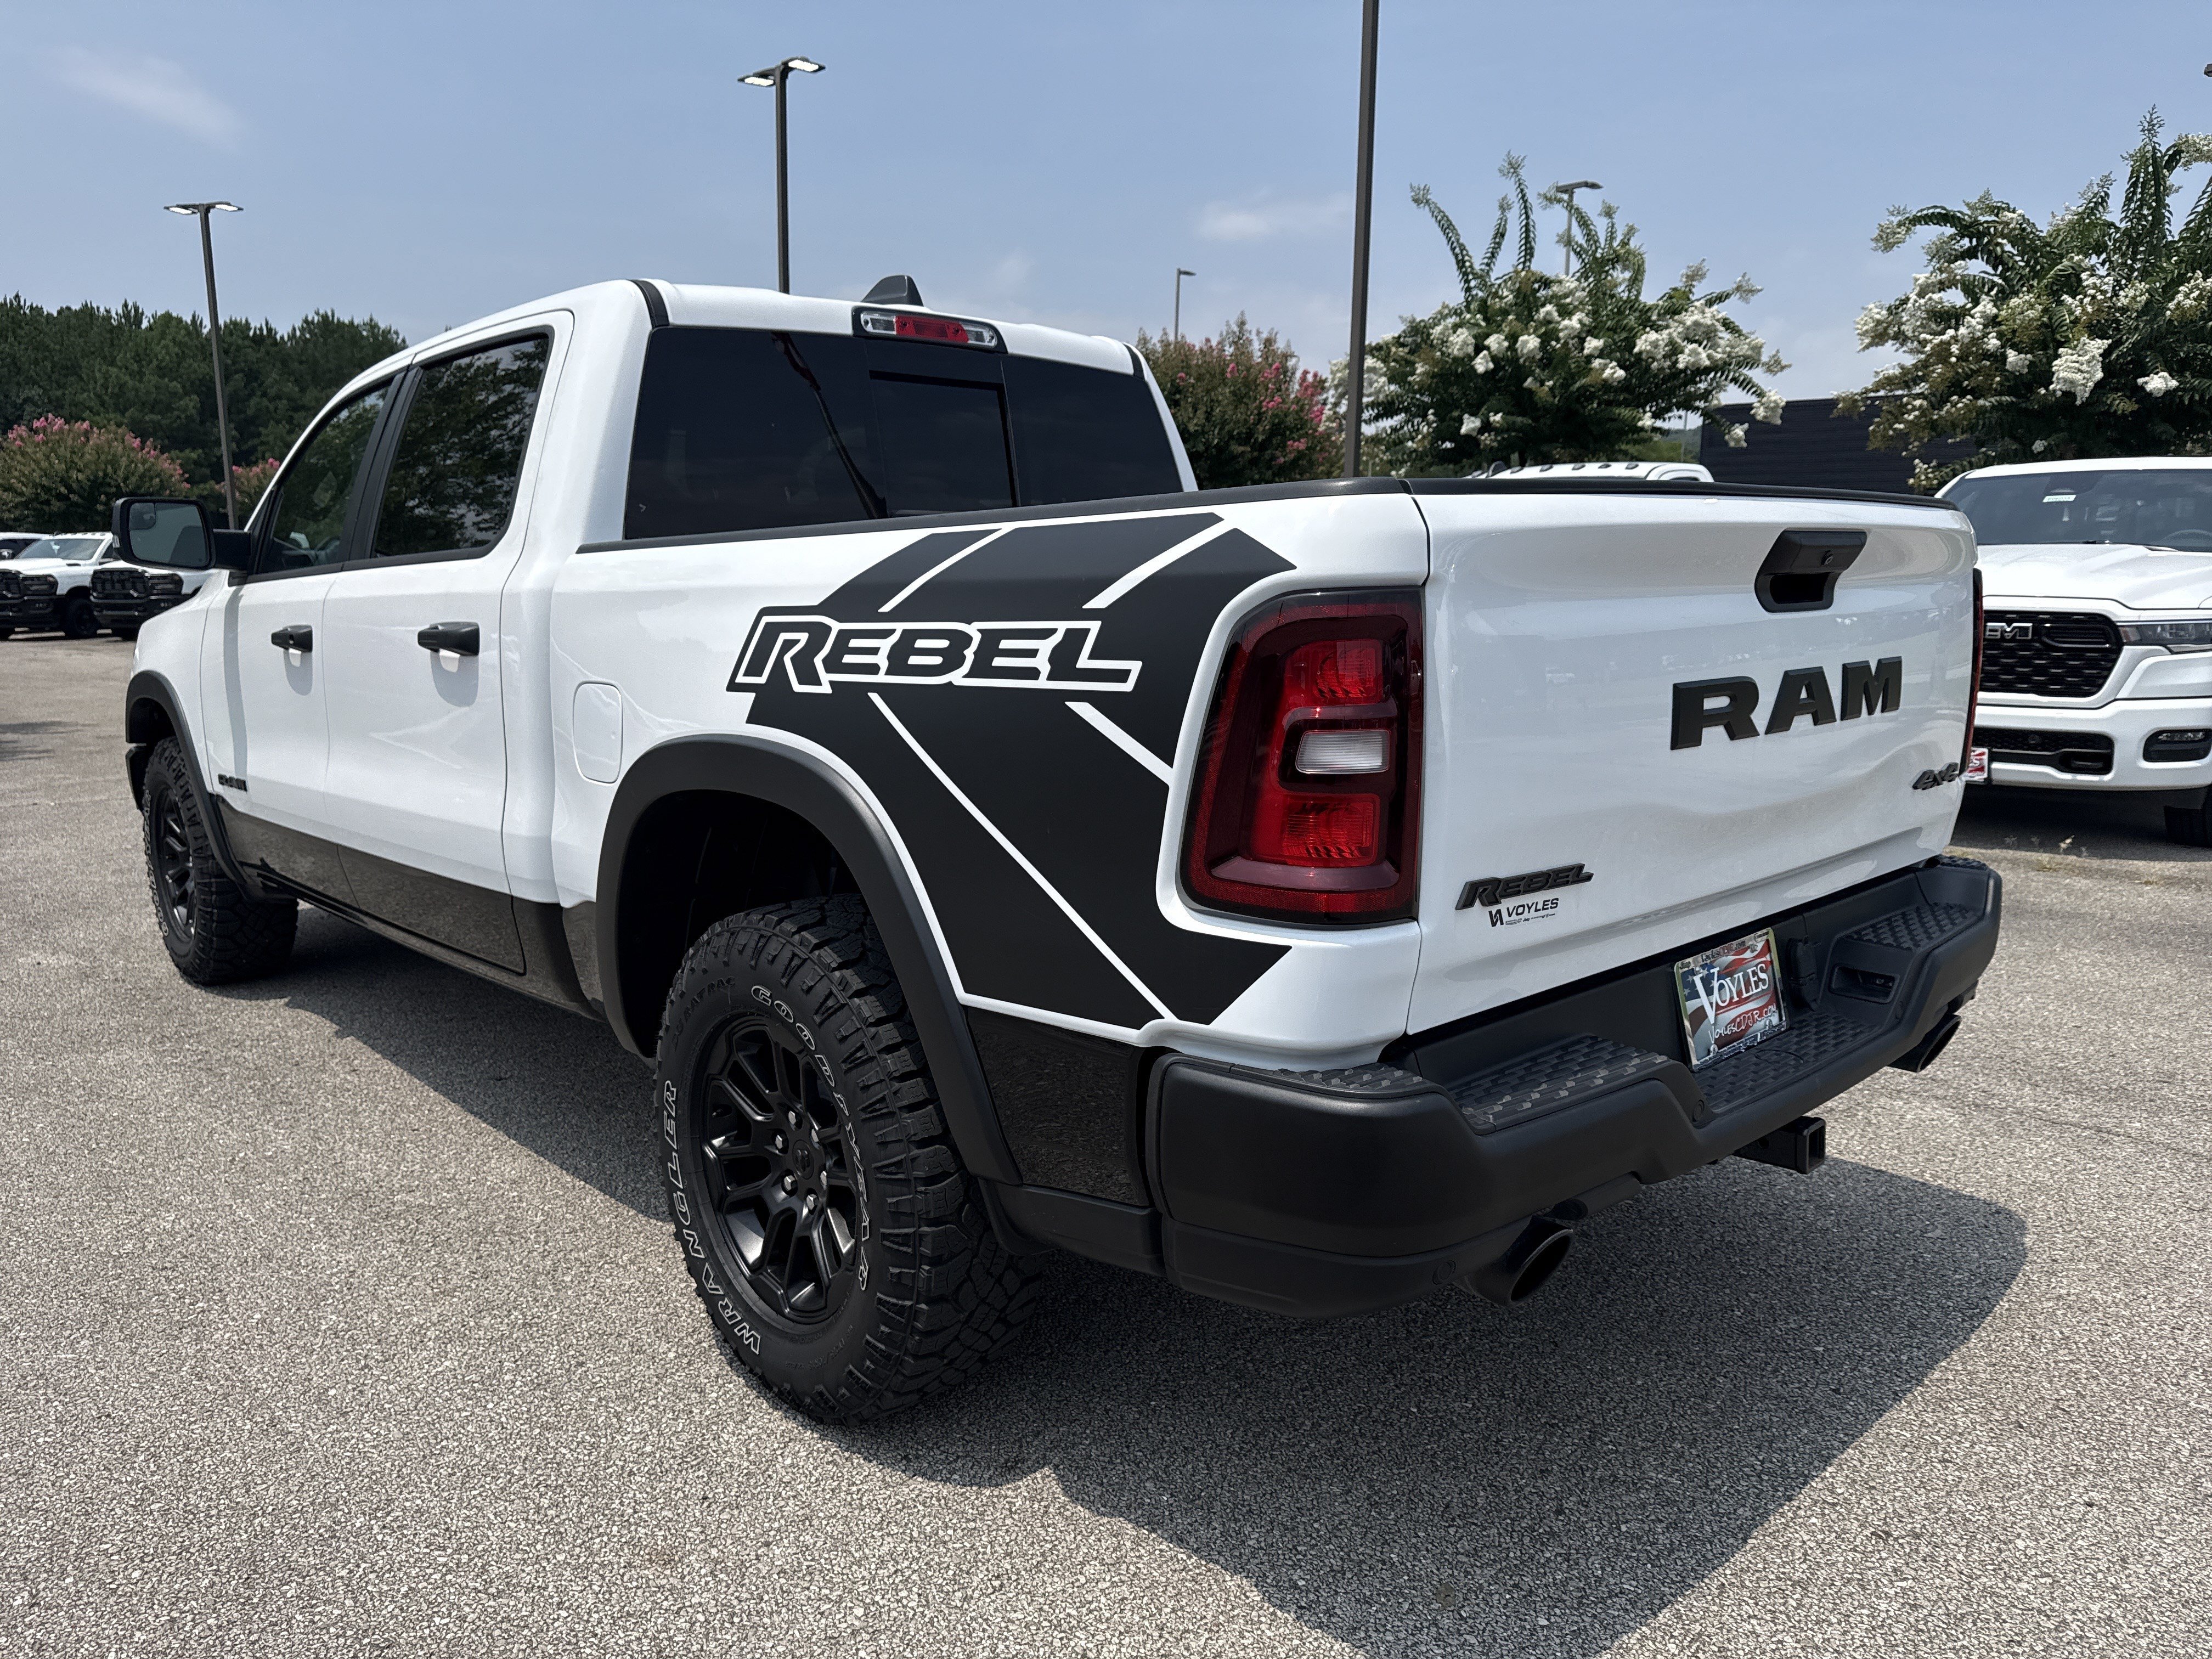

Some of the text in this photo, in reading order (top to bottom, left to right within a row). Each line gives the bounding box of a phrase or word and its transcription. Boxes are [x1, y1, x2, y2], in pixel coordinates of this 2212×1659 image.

[735, 614, 1143, 694] REBEL
[1670, 656, 1903, 751] RAM
[1455, 863, 1594, 911] REBEL
[1506, 898, 1559, 918] VOYLES
[1693, 963, 1769, 1025] VOYLES
[751, 985, 870, 1291] GOODYEAR
[663, 1080, 762, 1355] WRANGLER
